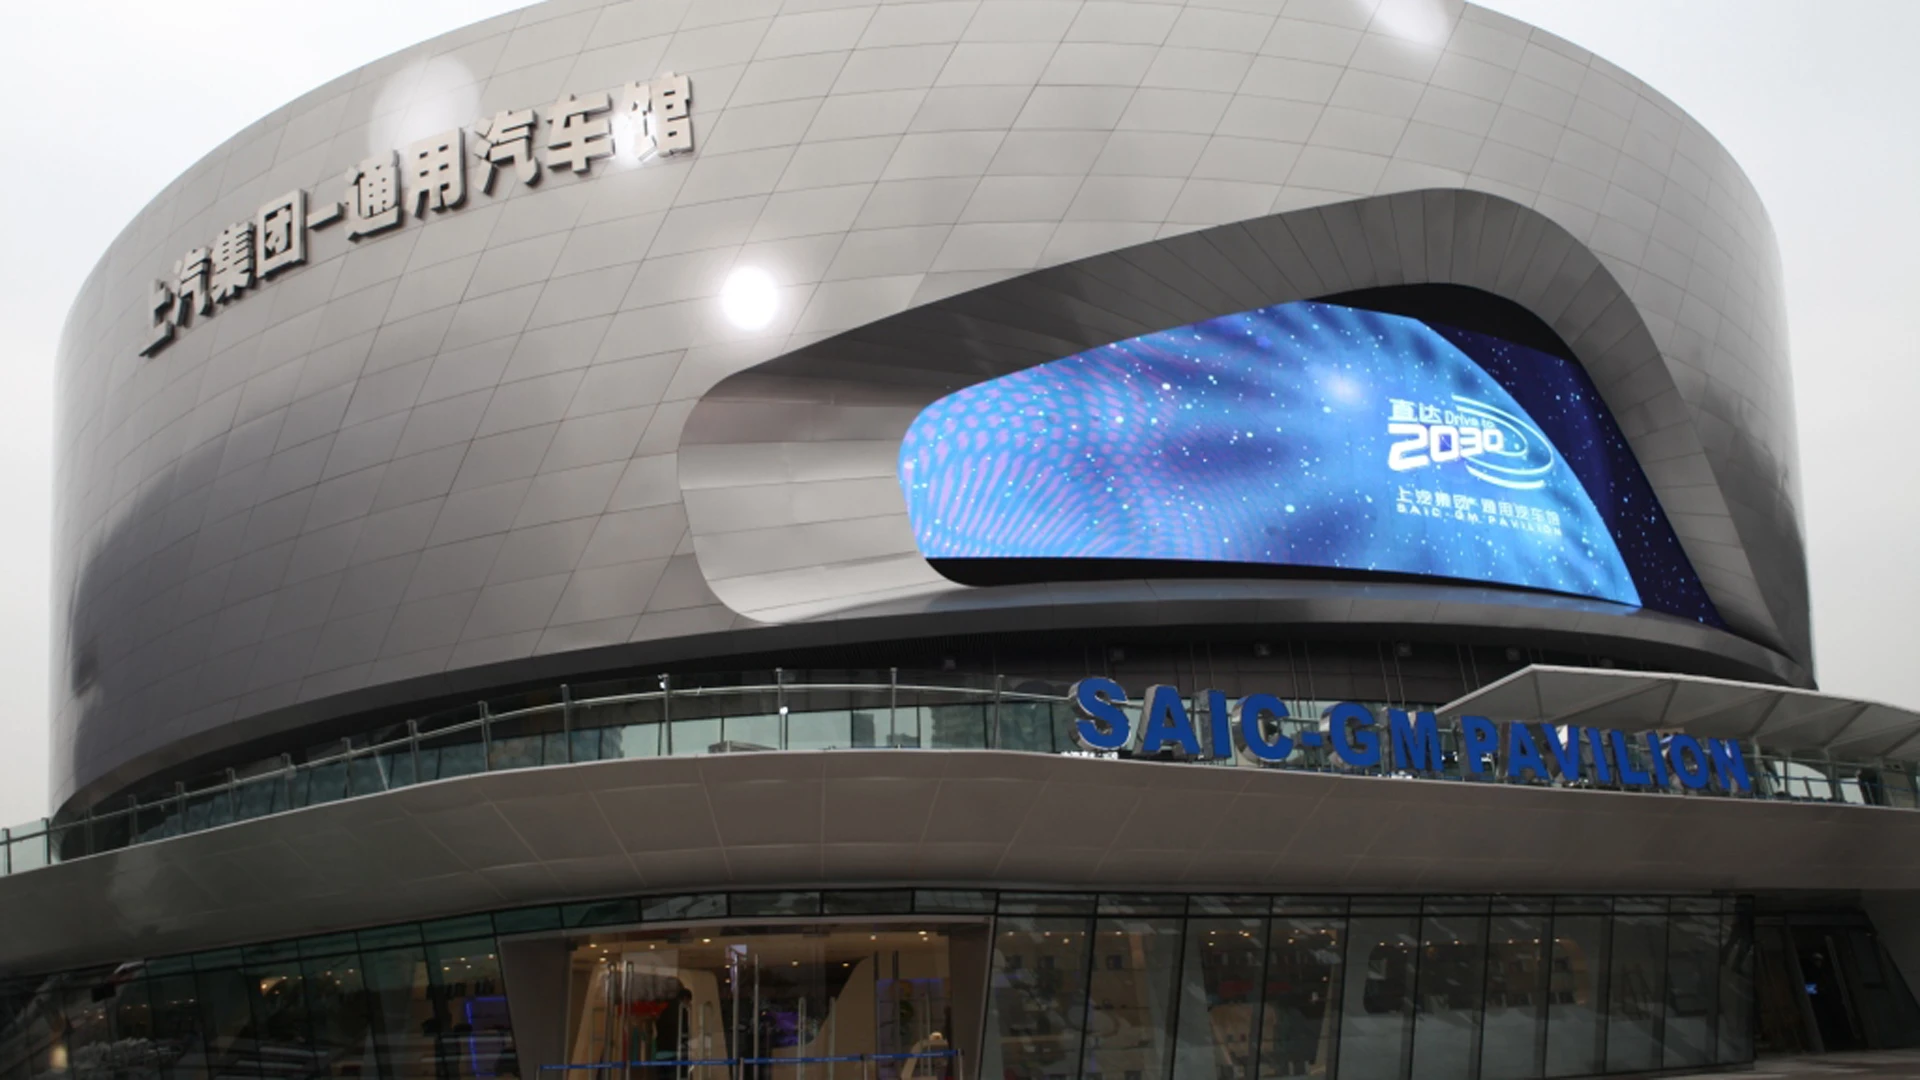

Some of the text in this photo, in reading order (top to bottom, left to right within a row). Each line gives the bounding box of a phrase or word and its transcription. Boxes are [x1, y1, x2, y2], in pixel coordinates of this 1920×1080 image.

[1387, 398, 1442, 424] 直达
[1444, 409, 1480, 428] Drive
[1387, 423, 1505, 472] 2030
[1070, 677, 1750, 791] SAIC-GM PAVILION
